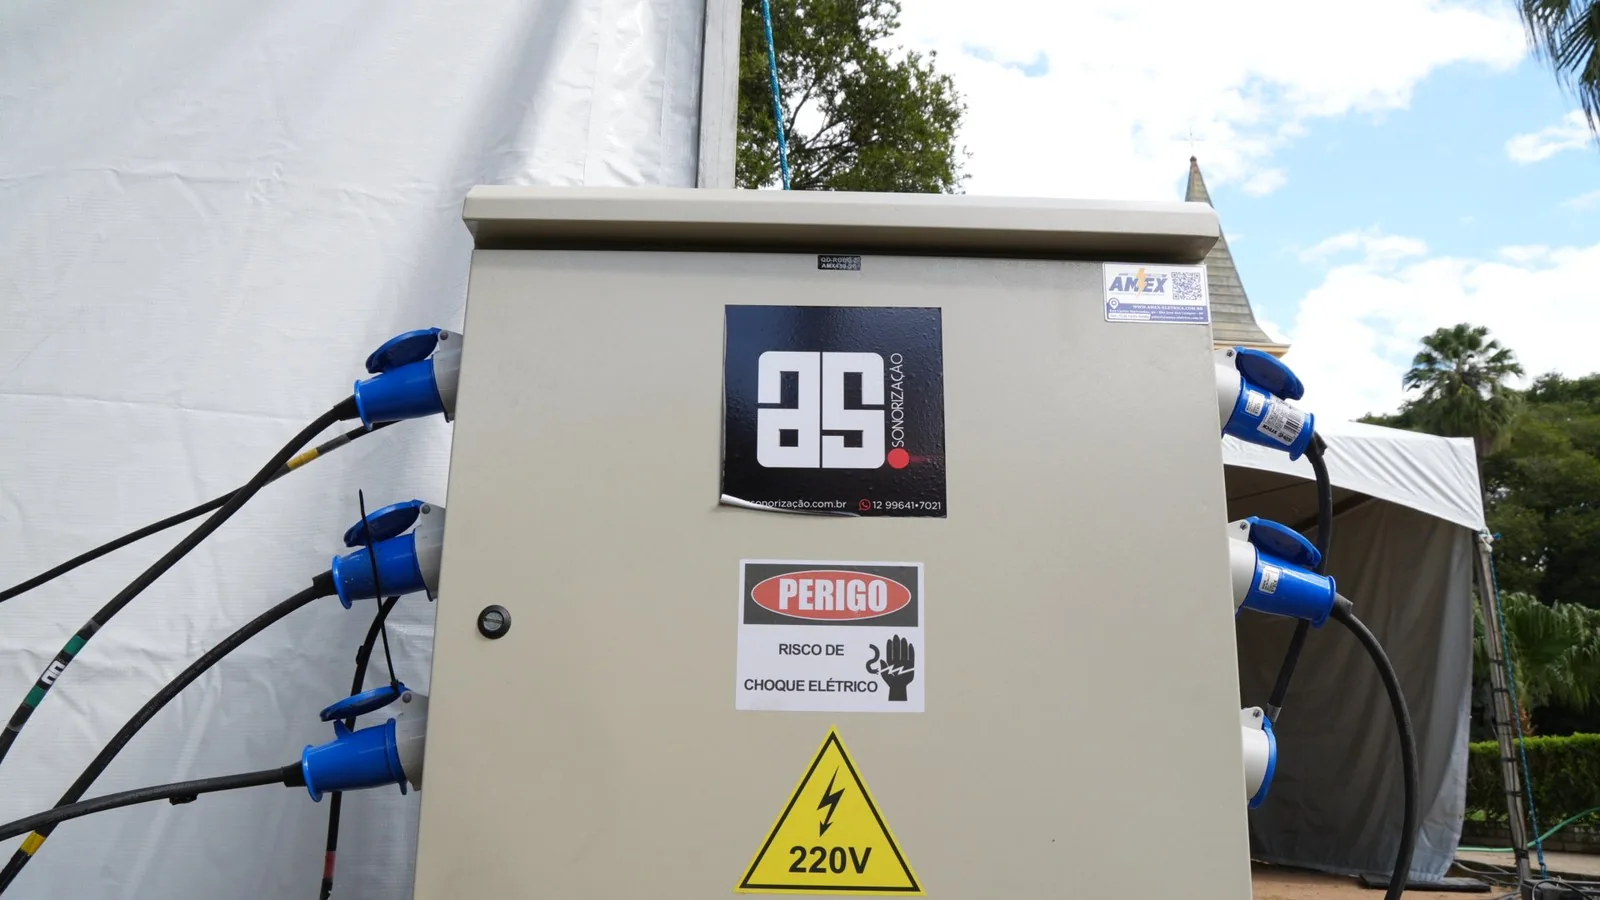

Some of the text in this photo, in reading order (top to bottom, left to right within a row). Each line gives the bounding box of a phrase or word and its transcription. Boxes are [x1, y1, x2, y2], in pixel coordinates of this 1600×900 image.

[1109, 276, 1168, 293] AMEX
[890, 352, 905, 448] SONORIZAÇÃO
[872, 501, 882, 510] 12
[778, 578, 888, 612] PERIGO
[778, 643, 845, 656] RISCO DE
[744, 677, 878, 693] CHOQUE ELÉTRICO
[788, 845, 872, 874] 220V
